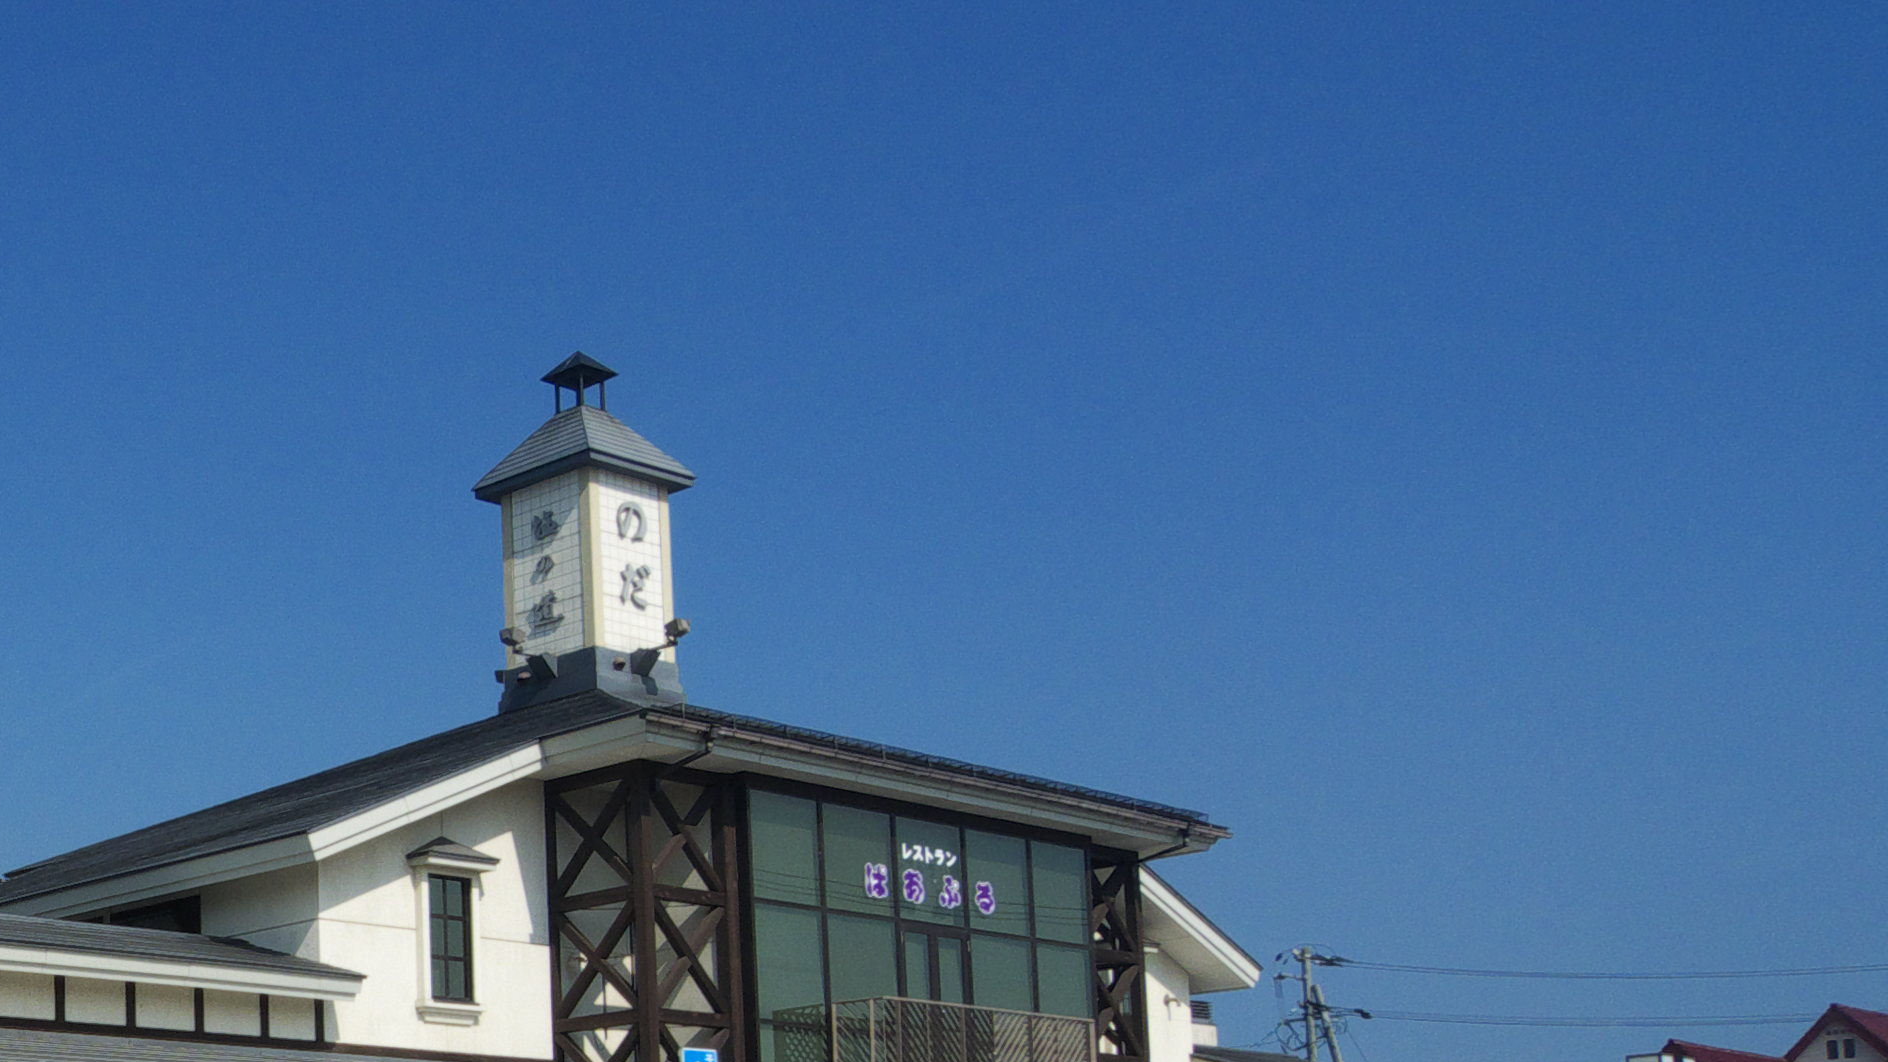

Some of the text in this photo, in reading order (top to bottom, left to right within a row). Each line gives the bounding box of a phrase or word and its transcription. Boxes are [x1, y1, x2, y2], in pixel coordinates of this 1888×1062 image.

[529, 510, 565, 630] 塩の道
[616, 501, 651, 611] のだ
[901, 843, 957, 867] レストラン
